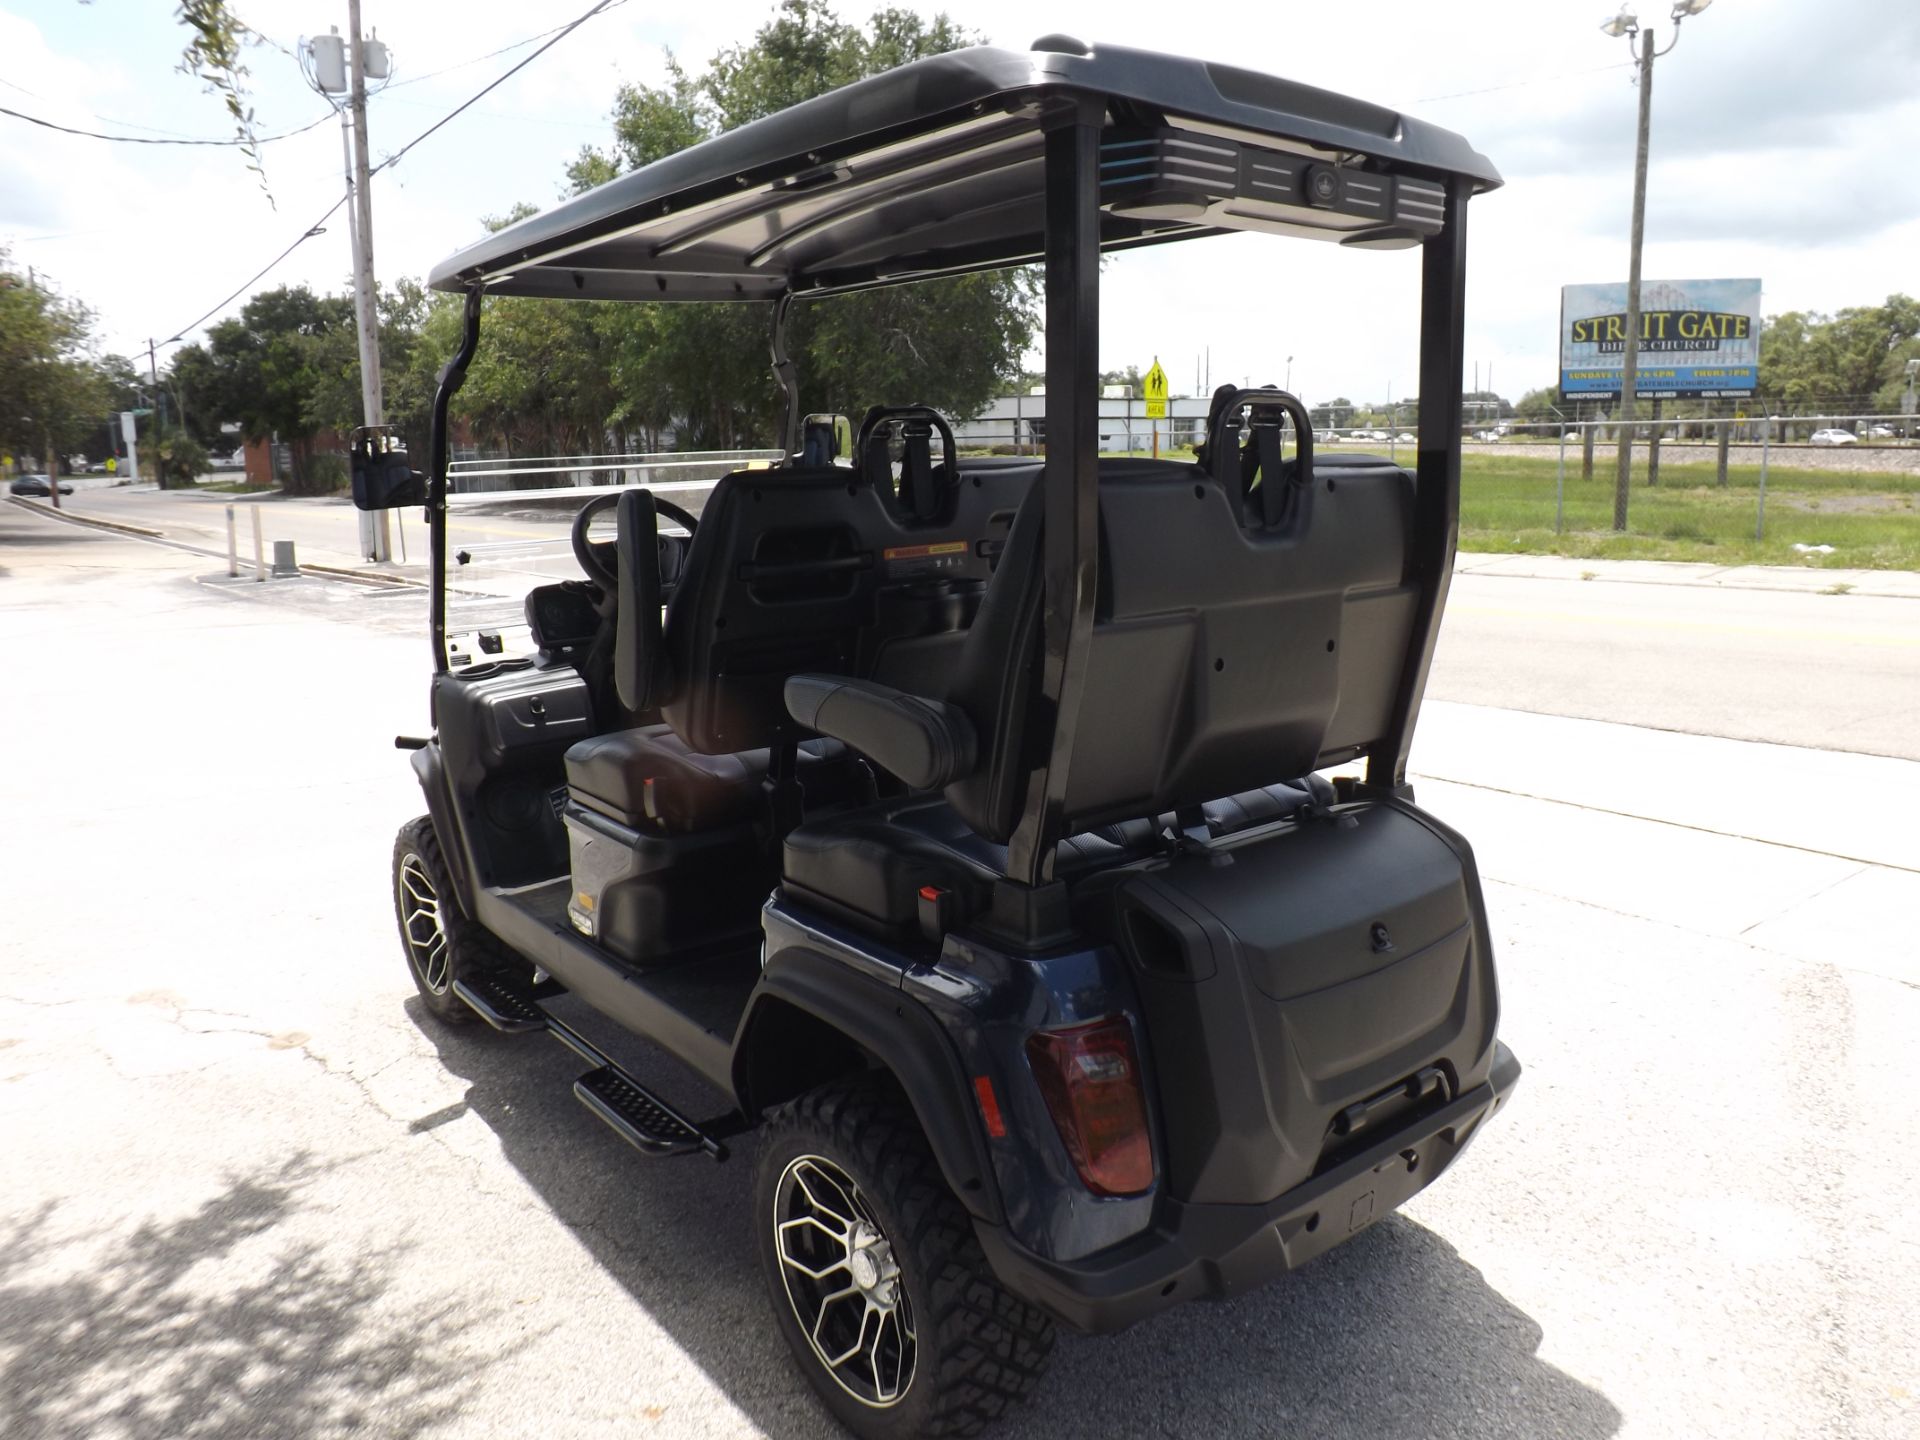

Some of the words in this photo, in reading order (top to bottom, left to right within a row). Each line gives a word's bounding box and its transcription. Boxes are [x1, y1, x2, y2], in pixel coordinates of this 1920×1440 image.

[1574, 312, 1670, 342] STRIT
[1678, 312, 1747, 339] GATE
[1602, 341, 1648, 352] BIE
[1650, 339, 1717, 351] CHURCH
